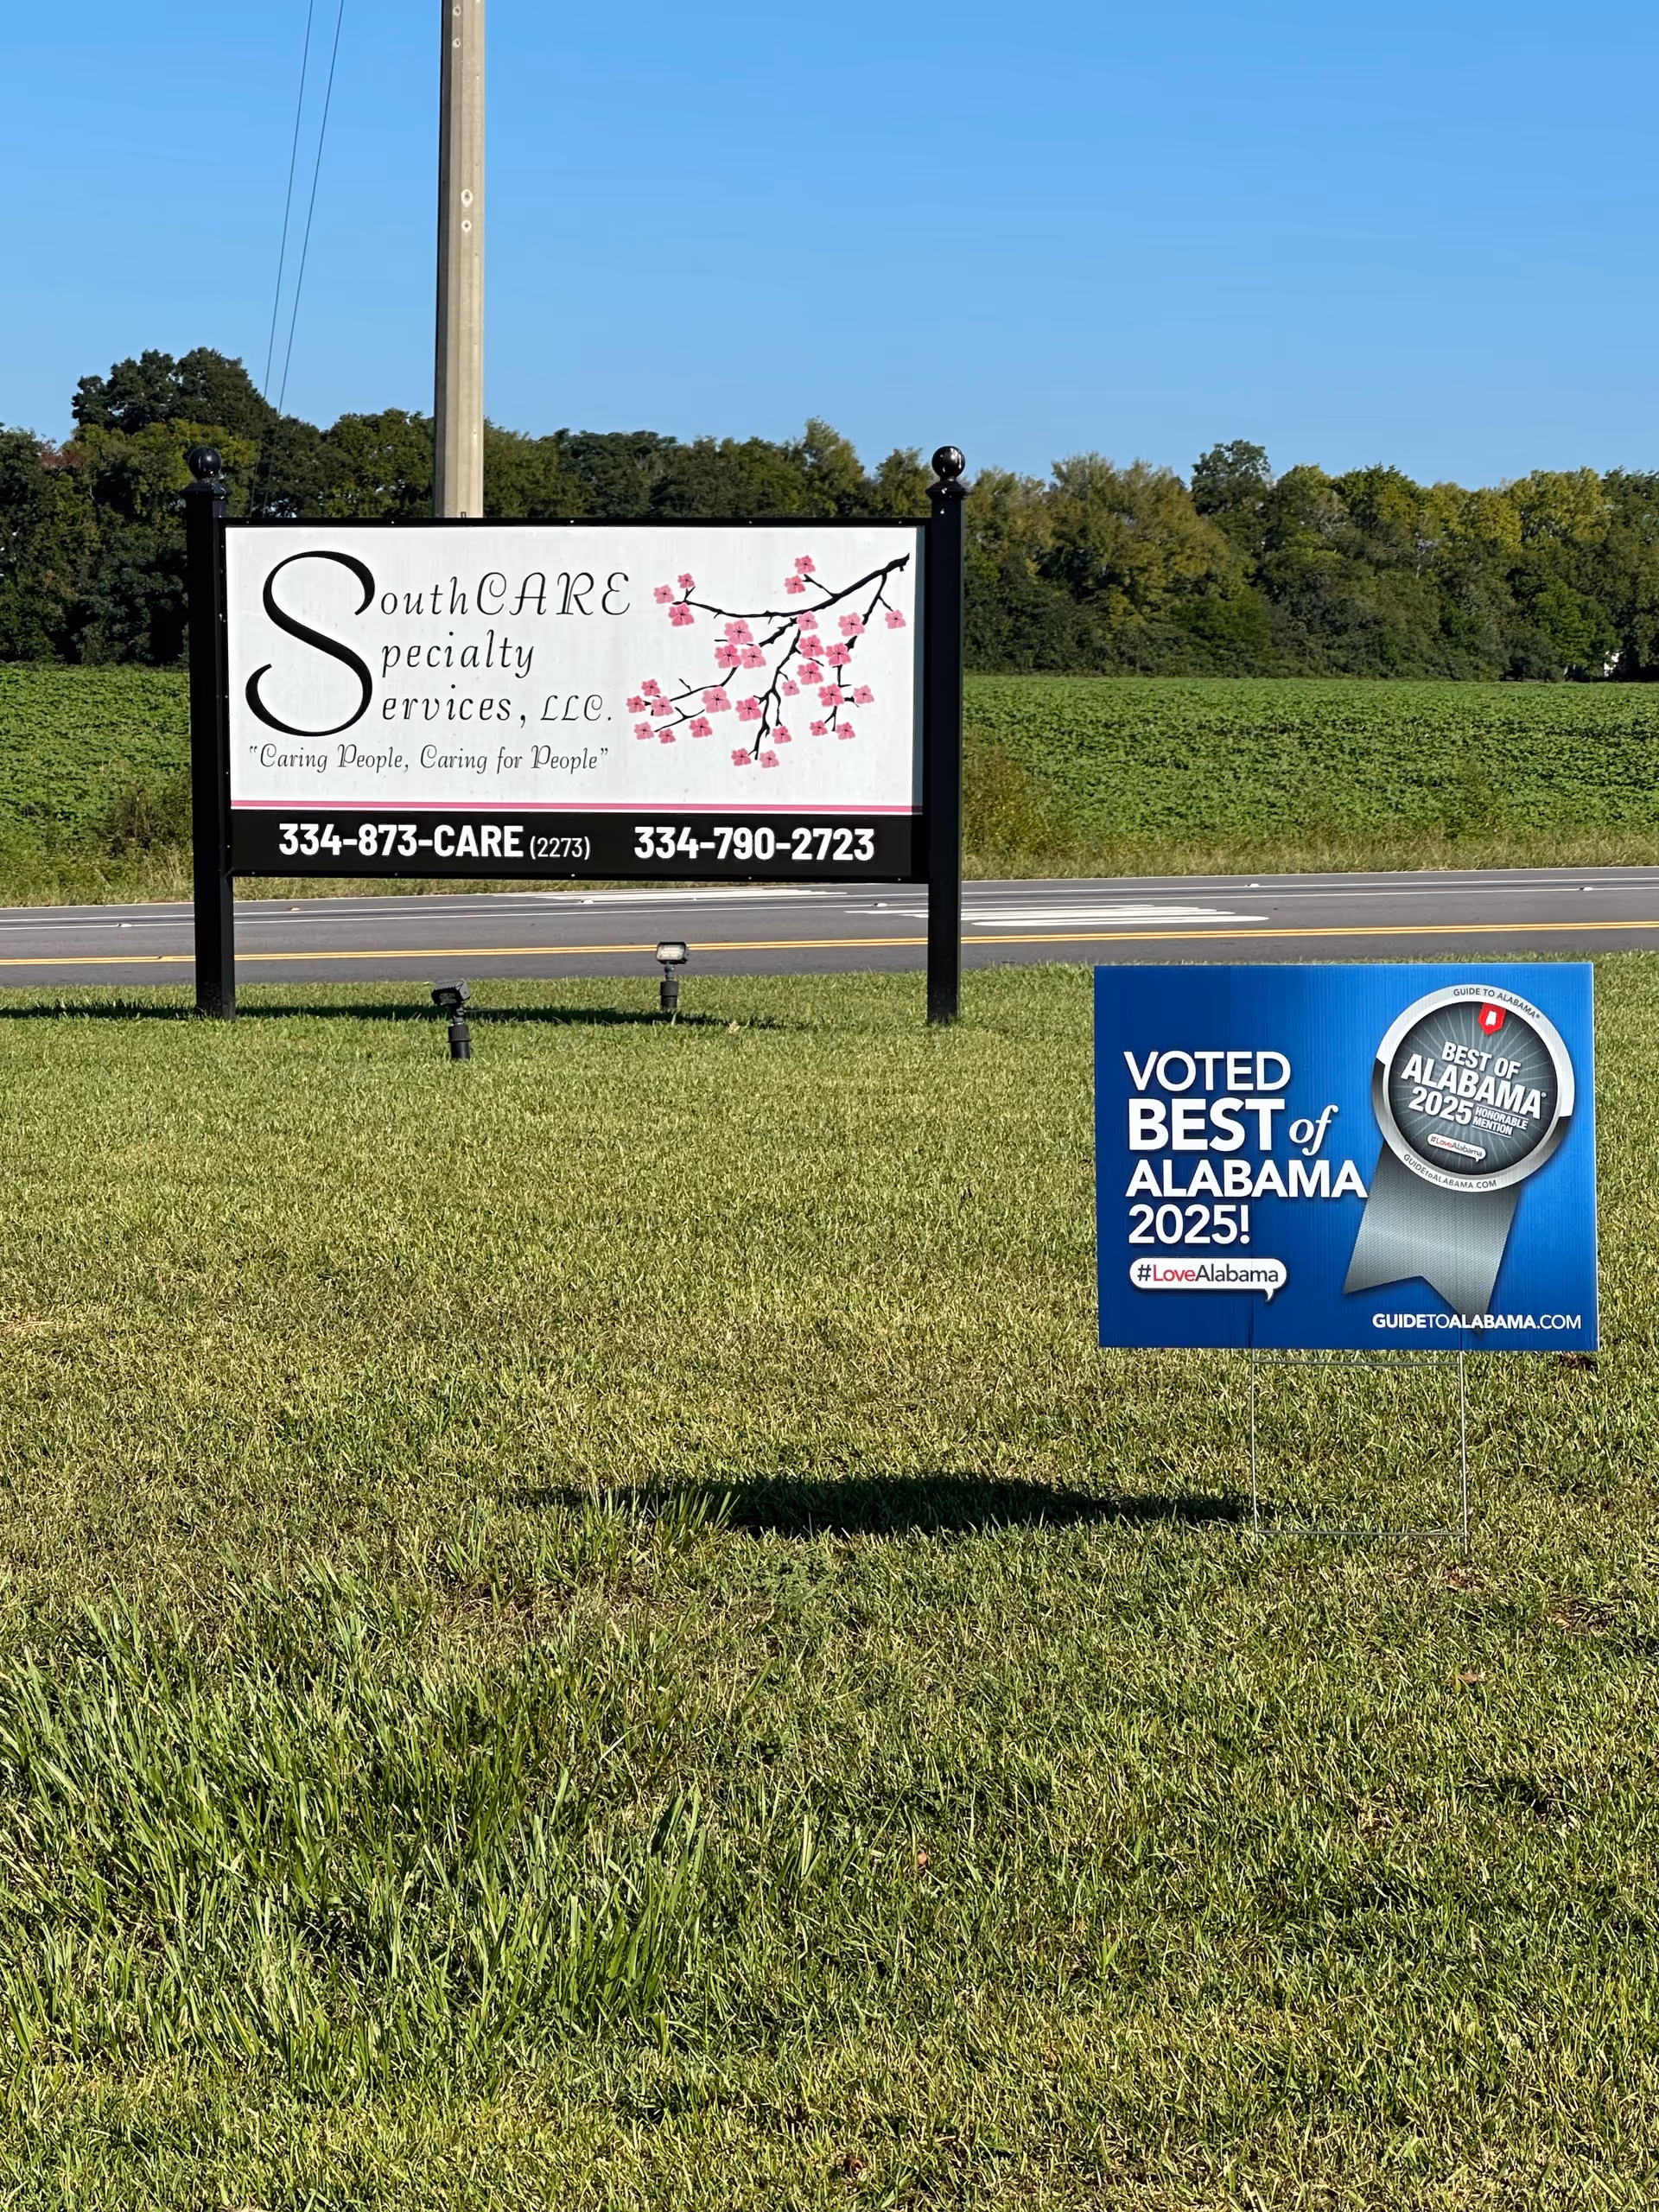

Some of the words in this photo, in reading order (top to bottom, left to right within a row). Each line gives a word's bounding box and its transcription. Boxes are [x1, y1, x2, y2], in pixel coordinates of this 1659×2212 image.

[540, 694, 613, 721] LLC.
[337, 744, 409, 774] People,
[420, 744, 487, 774] Caring
[496, 747, 524, 774] for
[278, 823, 524, 858] 334-873-CARE
[530, 836, 591, 861] (2273)
[634, 826, 875, 861] 334-790-2723
[1452, 988, 1480, 997] GUIDE
[1483, 988, 1496, 997] TO
[1123, 1051, 1291, 1091] VOTED
[1441, 1040, 1492, 1072] BEST
[1494, 1057, 1522, 1079] OF
[1408, 1087, 1474, 1126] 2025
[1475, 1106, 1529, 1130] HONORABLE
[1128, 1096, 1286, 1152] BEST
[1288, 1103, 1339, 1155] of
[1472, 1116, 1514, 1136] MENTION
[1430, 1135, 1483, 1158] #LoveAlabama
[1125, 1160, 1369, 1198] ALABAMA
[1128, 1204, 1250, 1244] 2025!
[1137, 1263, 1280, 1283] #LoveAlabama
[1372, 1313, 1581, 1330] GUIDETOALABAMA.COM
